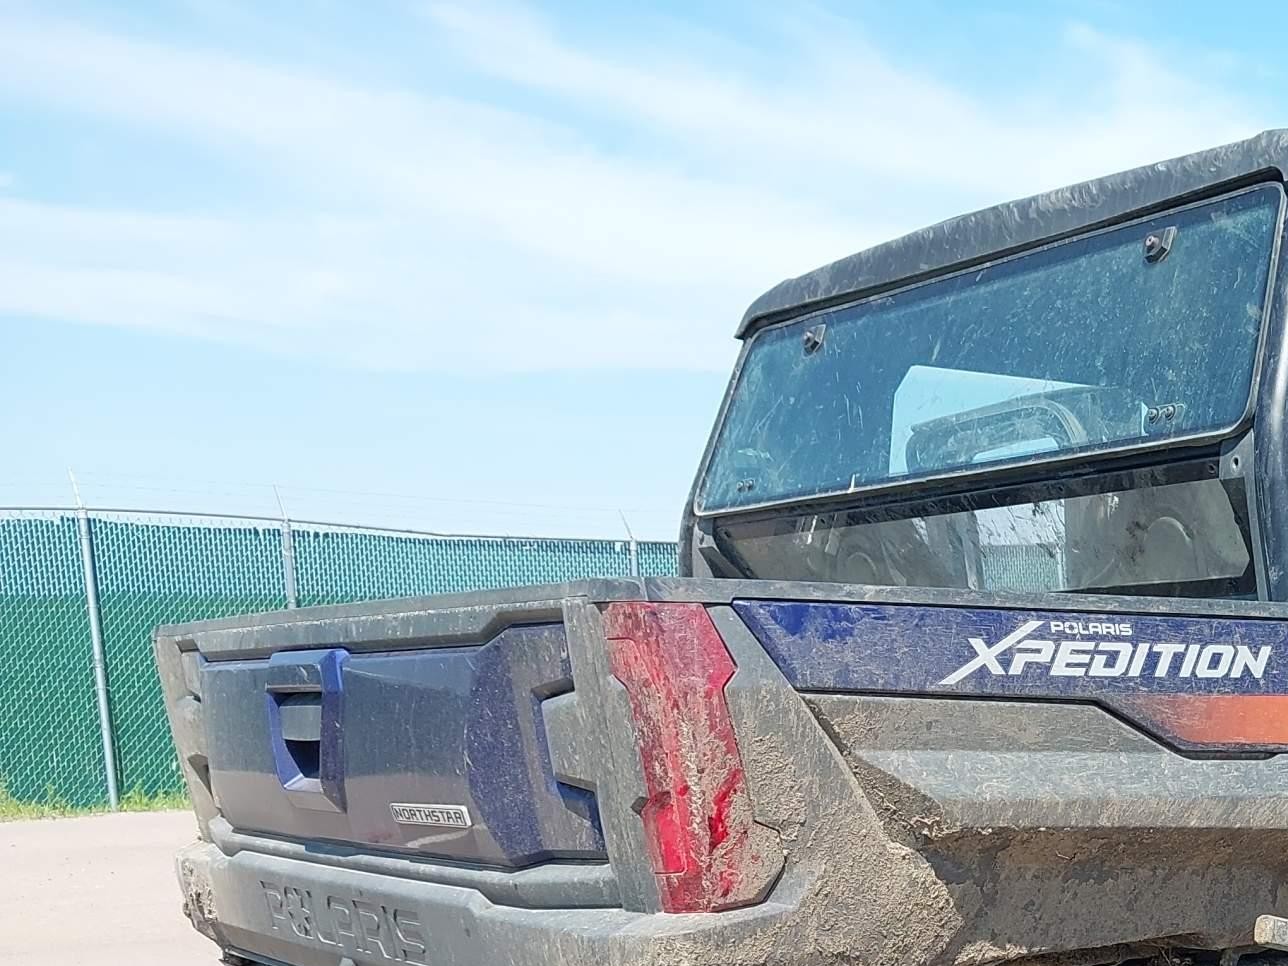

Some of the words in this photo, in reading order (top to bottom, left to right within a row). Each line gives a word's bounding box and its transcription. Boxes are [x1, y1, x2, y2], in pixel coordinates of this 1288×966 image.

[1050, 621, 1133, 636] POLARIS
[938, 620, 1272, 685] XPEDITION
[391, 806, 464, 825] NORTHSTAR
